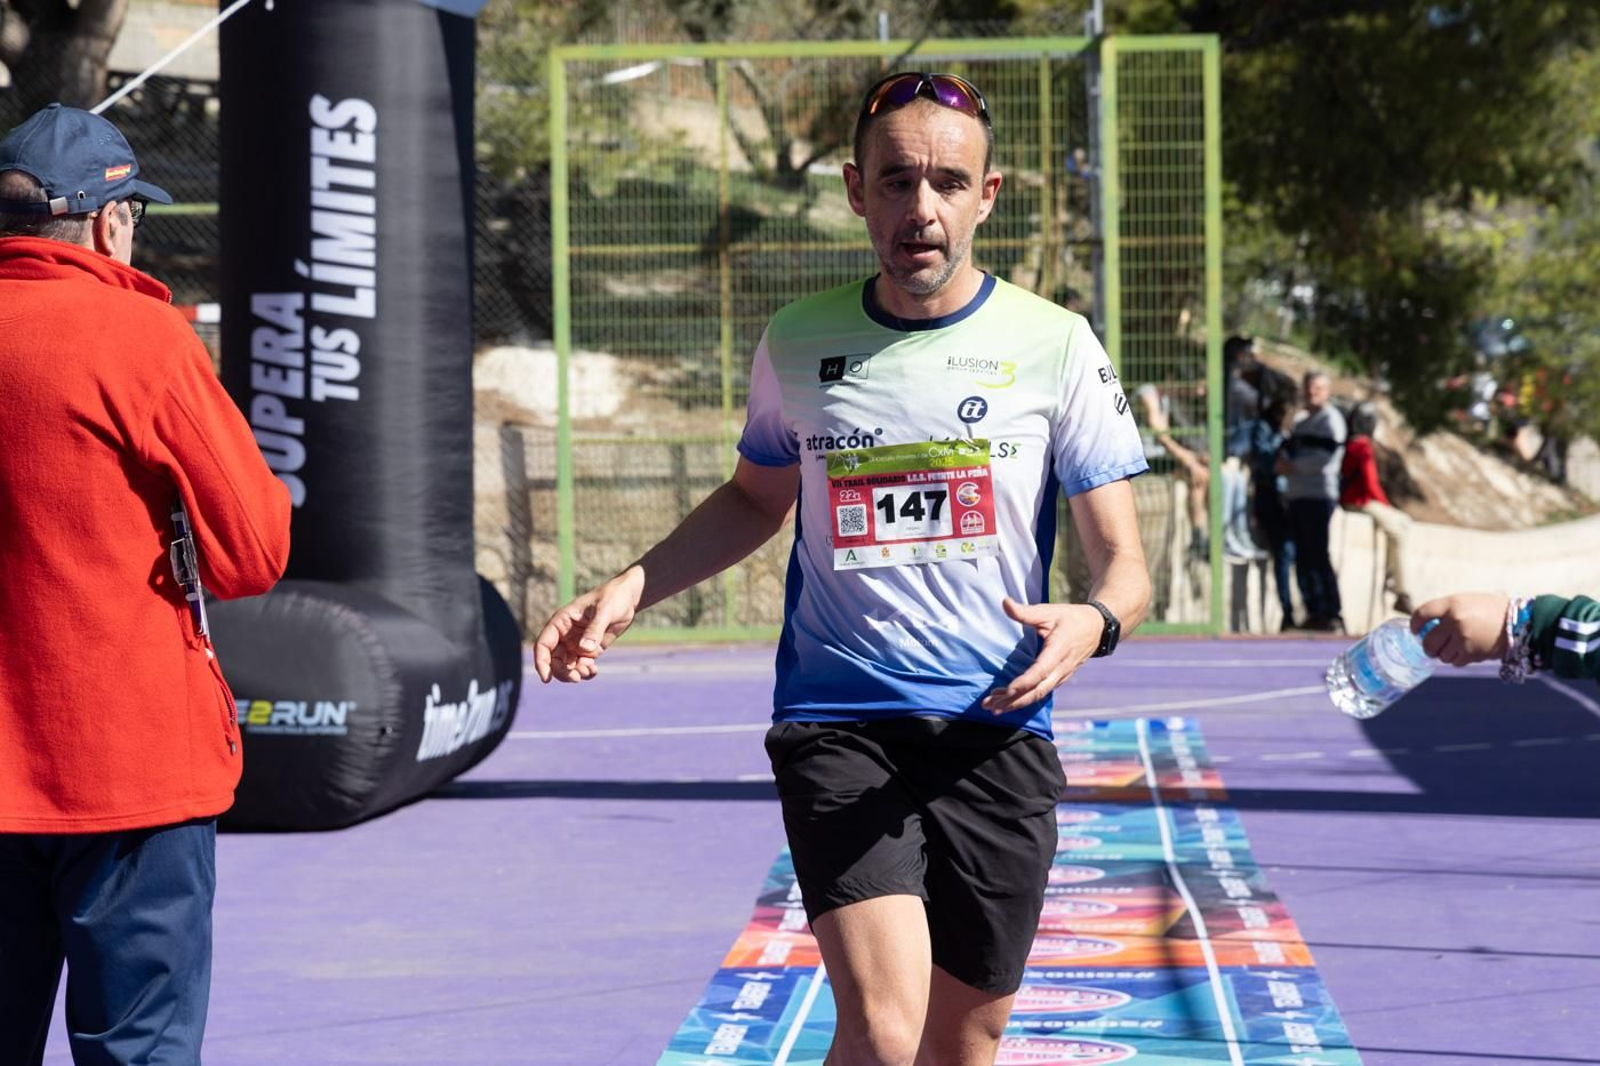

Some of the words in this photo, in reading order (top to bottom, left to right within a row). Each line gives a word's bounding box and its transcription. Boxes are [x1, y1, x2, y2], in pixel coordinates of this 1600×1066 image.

[294, 93, 377, 319] LÍMITES
[310, 325, 360, 402] TUS
[876, 490, 947, 524] 147
